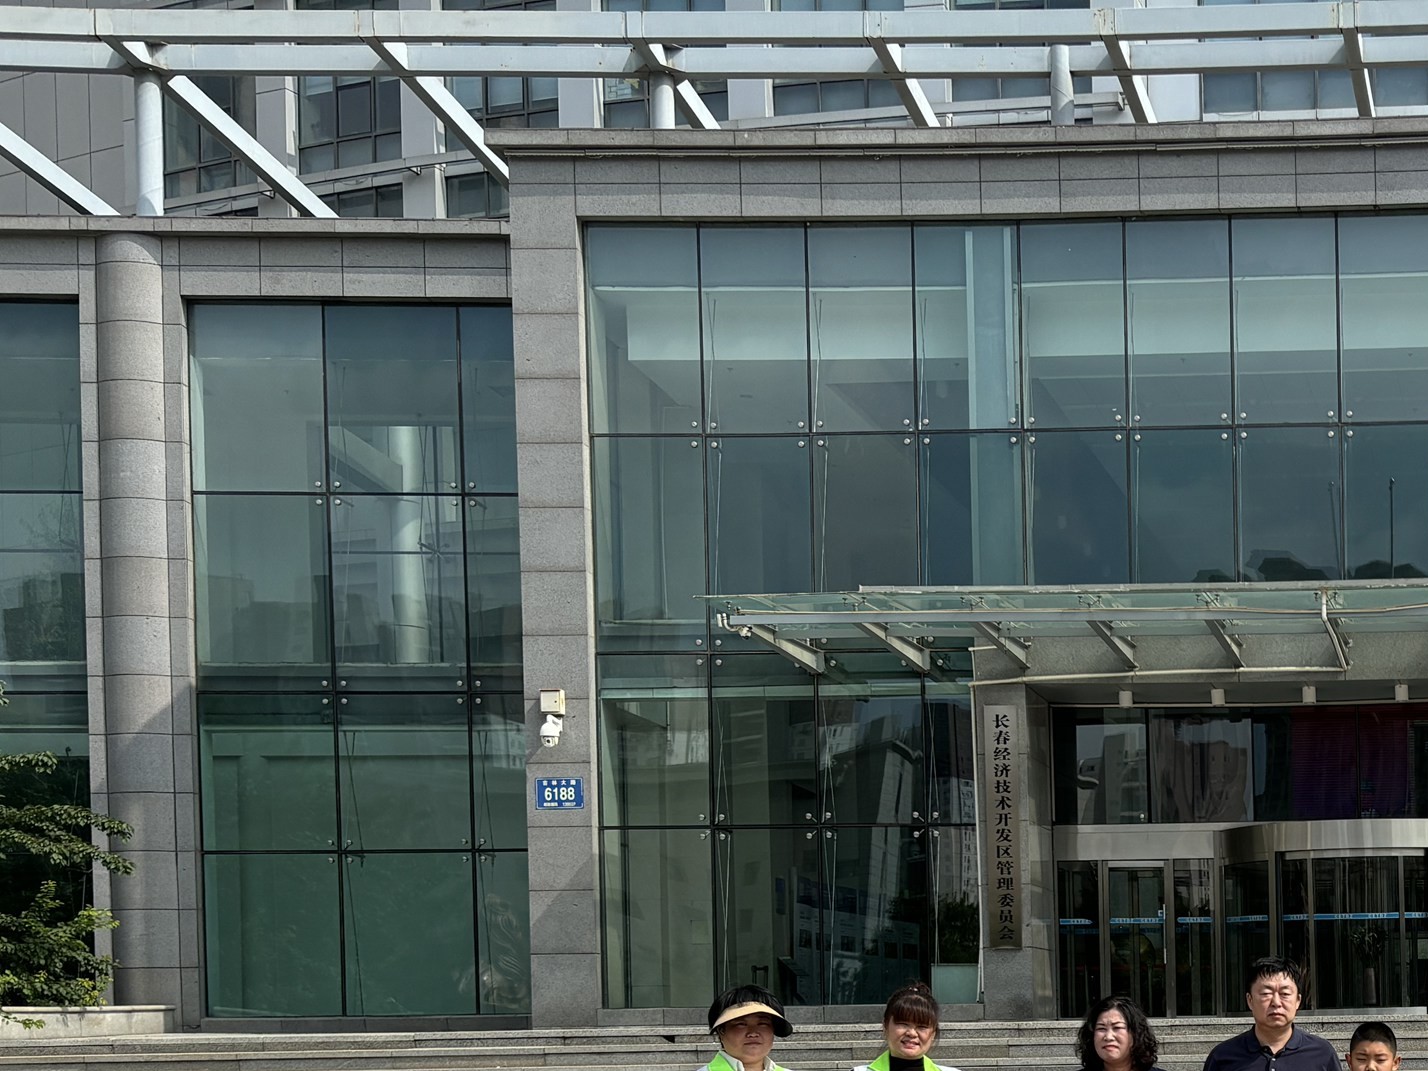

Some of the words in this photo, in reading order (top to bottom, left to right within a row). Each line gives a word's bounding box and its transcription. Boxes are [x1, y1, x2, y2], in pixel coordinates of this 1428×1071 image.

[544, 787, 576, 801] 6188
[992, 713, 1015, 941] 长春经济技术开发区管理委员会
